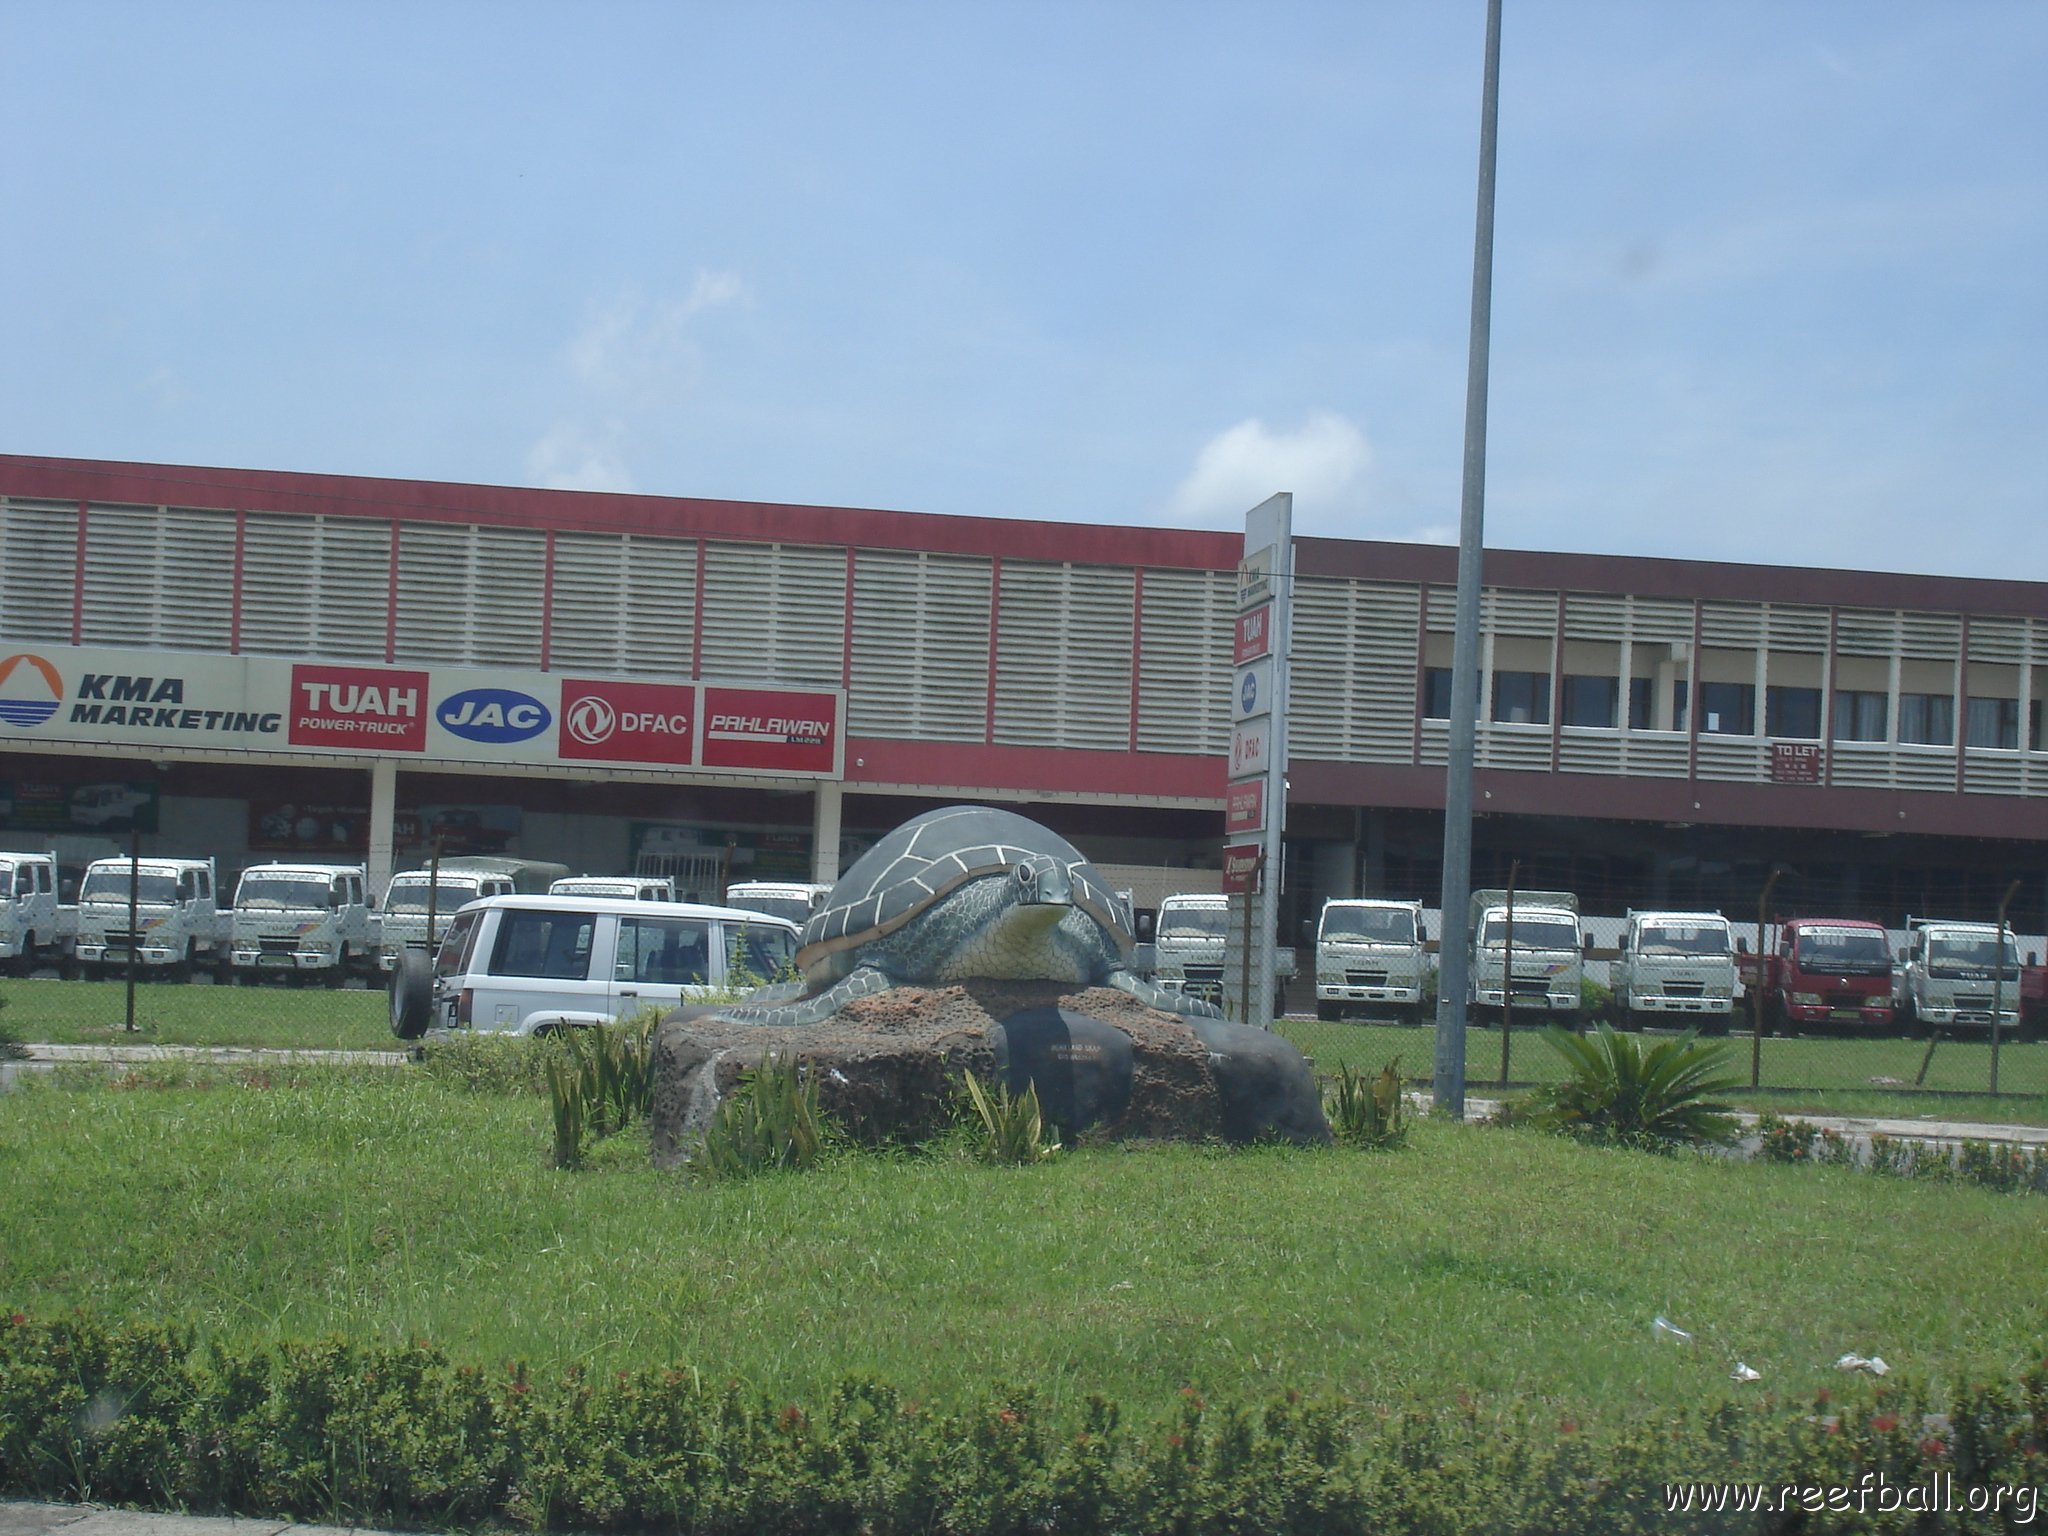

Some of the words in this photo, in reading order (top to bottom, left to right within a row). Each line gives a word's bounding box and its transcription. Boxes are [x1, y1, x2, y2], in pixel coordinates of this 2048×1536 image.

[1243, 612, 1262, 643] TUAH
[78, 674, 184, 704] KMA
[301, 682, 418, 717] TUAH
[69, 703, 282, 733] MARKETING
[299, 717, 409, 735] POWER-TRUCK
[444, 701, 542, 730] JAC
[620, 712, 687, 735] DFAC
[710, 715, 830, 737] PAHLAWAN
[1776, 745, 1792, 756] TO
[1795, 746, 1818, 757] LET
